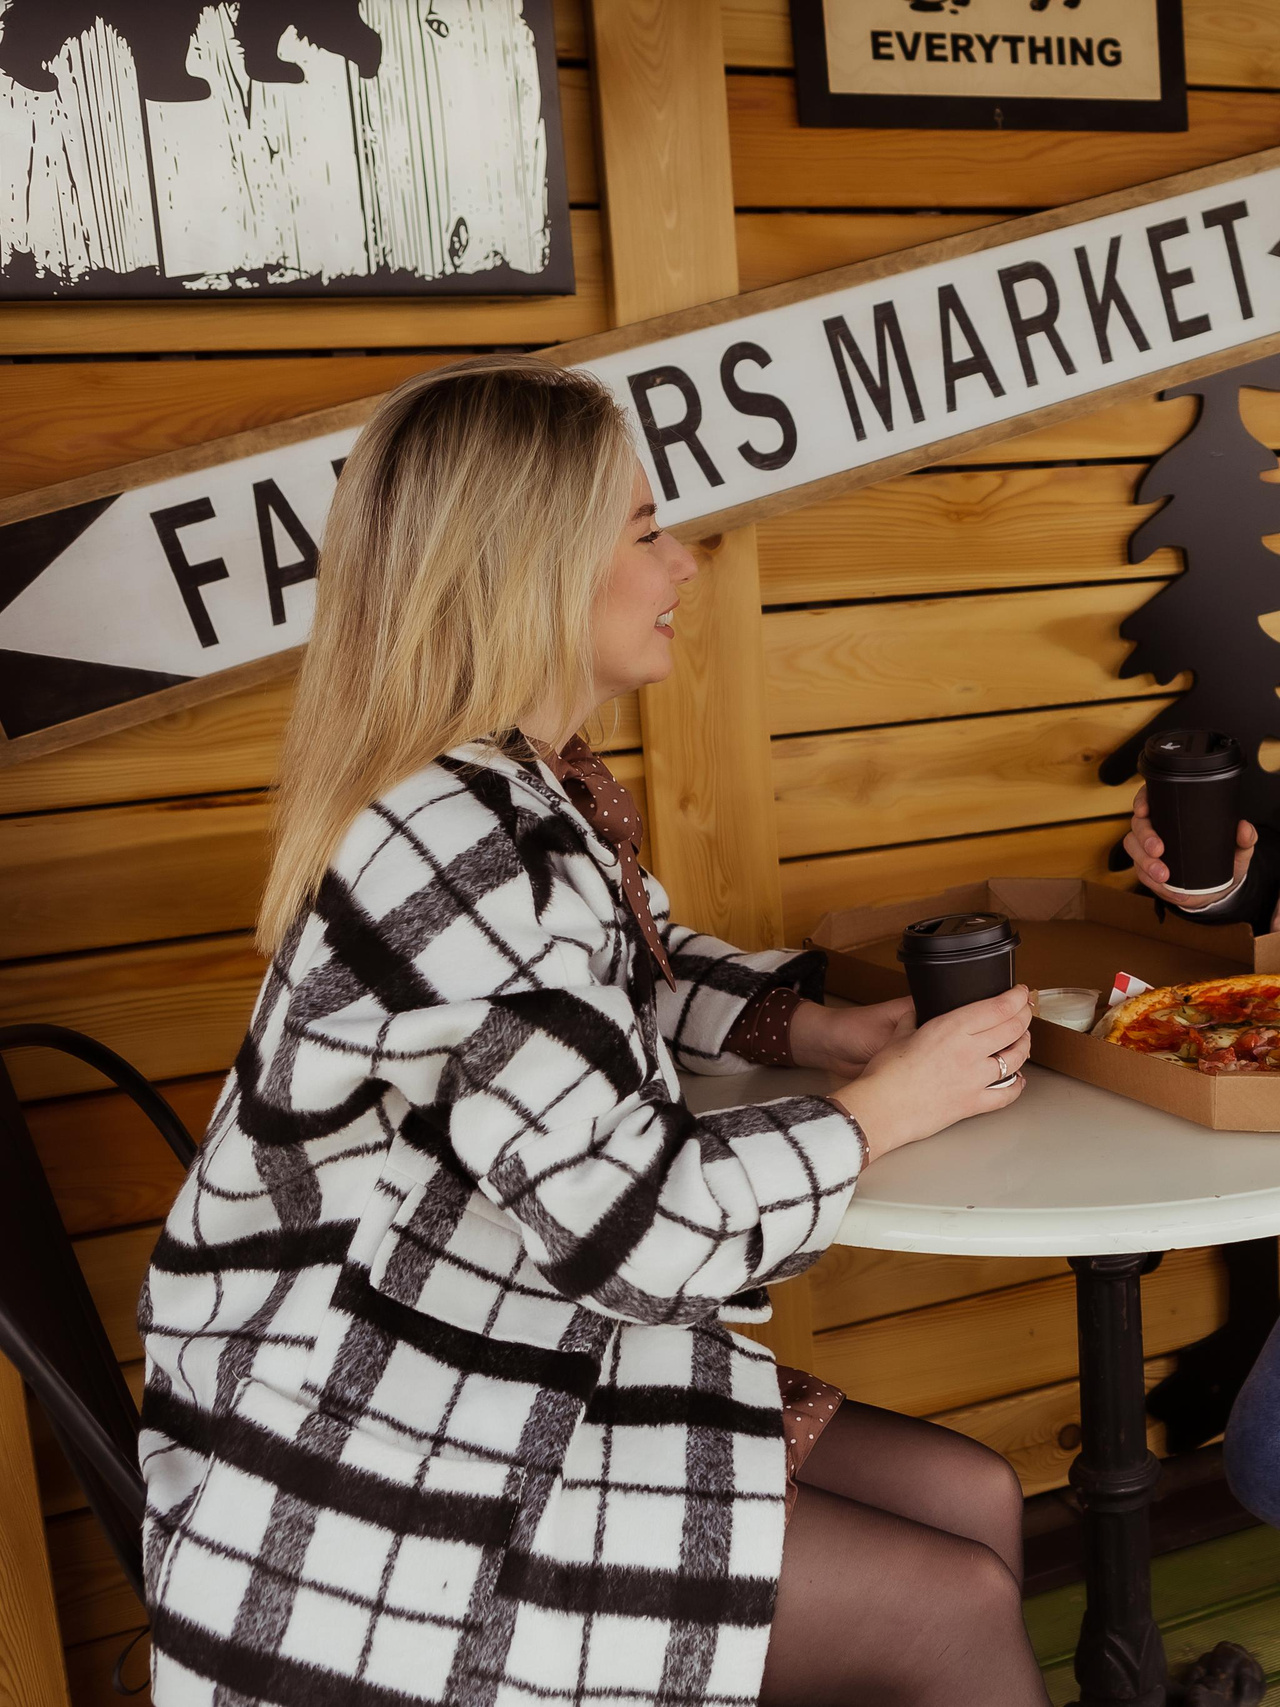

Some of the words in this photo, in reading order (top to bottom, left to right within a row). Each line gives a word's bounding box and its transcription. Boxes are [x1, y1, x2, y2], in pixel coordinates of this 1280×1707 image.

[870, 30, 1123, 67] EVERYTHING
[150, 341, 797, 648] FARS
[822, 201, 1255, 441] MARKET
